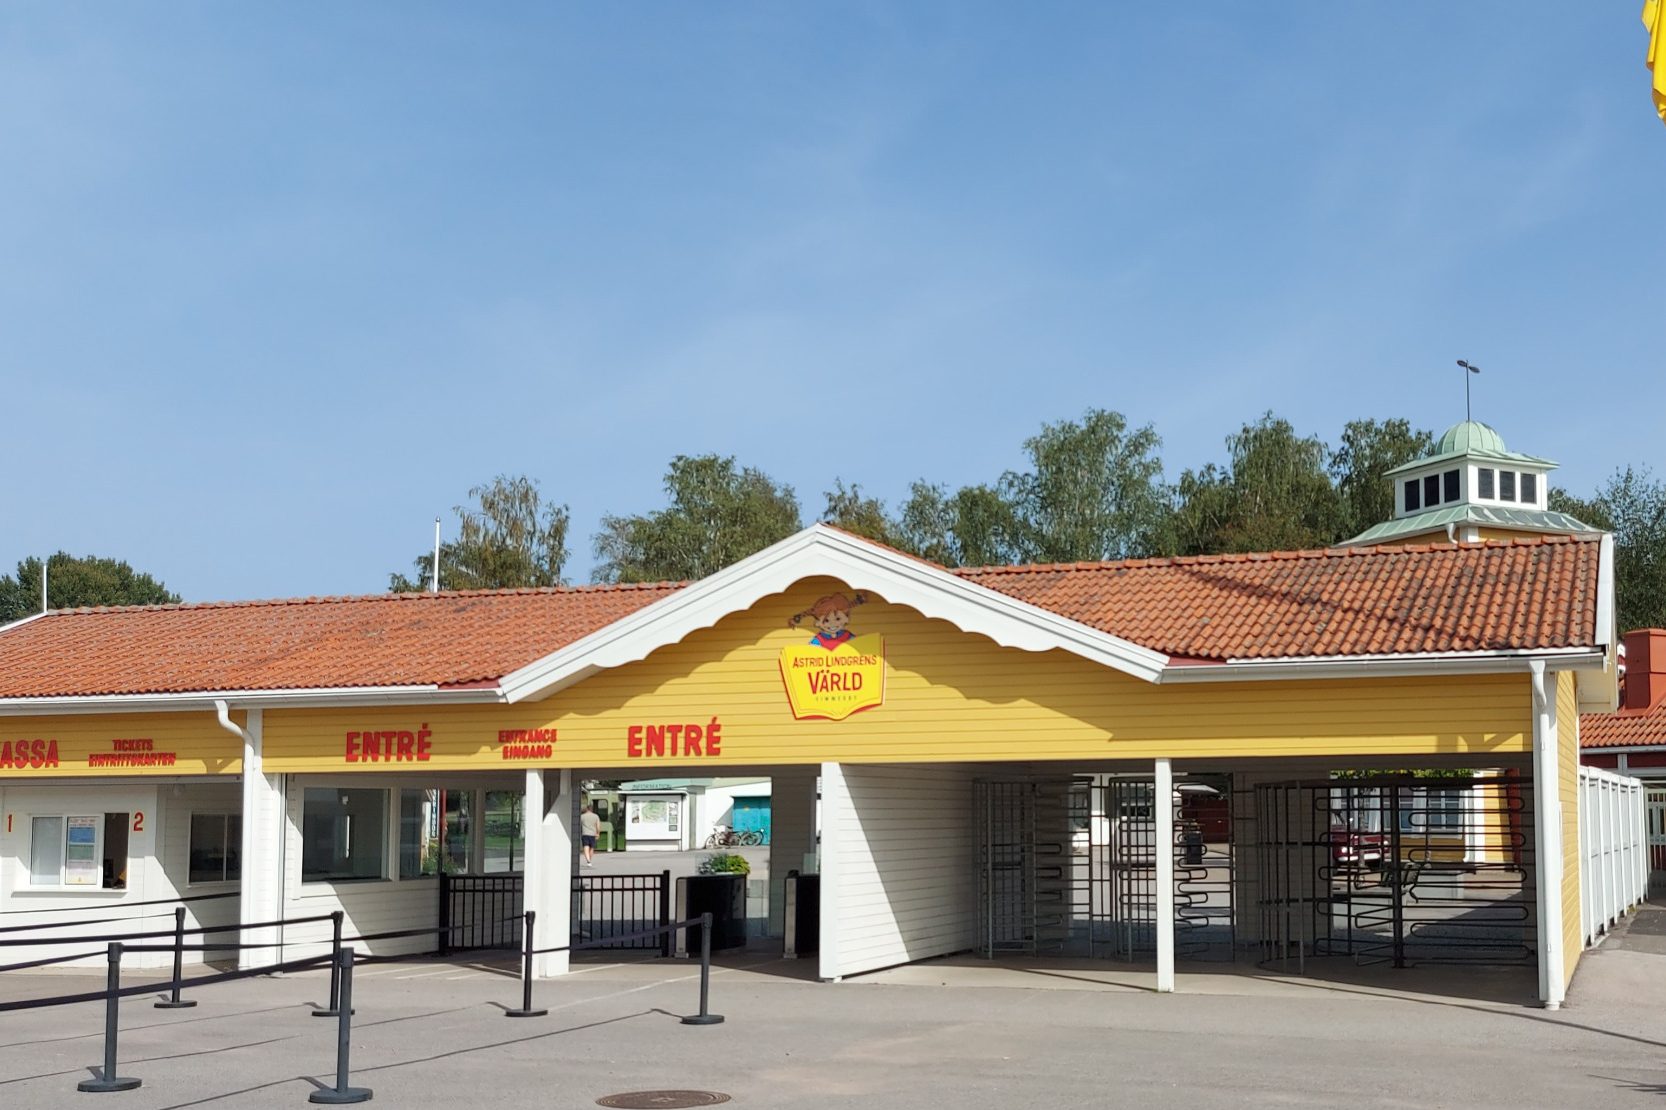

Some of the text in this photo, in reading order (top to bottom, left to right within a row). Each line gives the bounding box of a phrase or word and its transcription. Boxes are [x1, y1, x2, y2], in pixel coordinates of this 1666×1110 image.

[793, 655, 877, 669] ASTRID LINDGRENS
[808, 669, 863, 695] VÄRLD
[345, 723, 432, 762] ENTRÉ
[498, 729, 557, 743] ENTRANCE
[627, 716, 721, 757] ENTRÉ
[112, 738, 153, 752] TICKETS
[502, 745, 553, 760] EINGANG
[88, 752, 177, 768] EINTRITTSKARTEN
[7, 814, 13, 833] 1
[133, 811, 144, 832] 2
